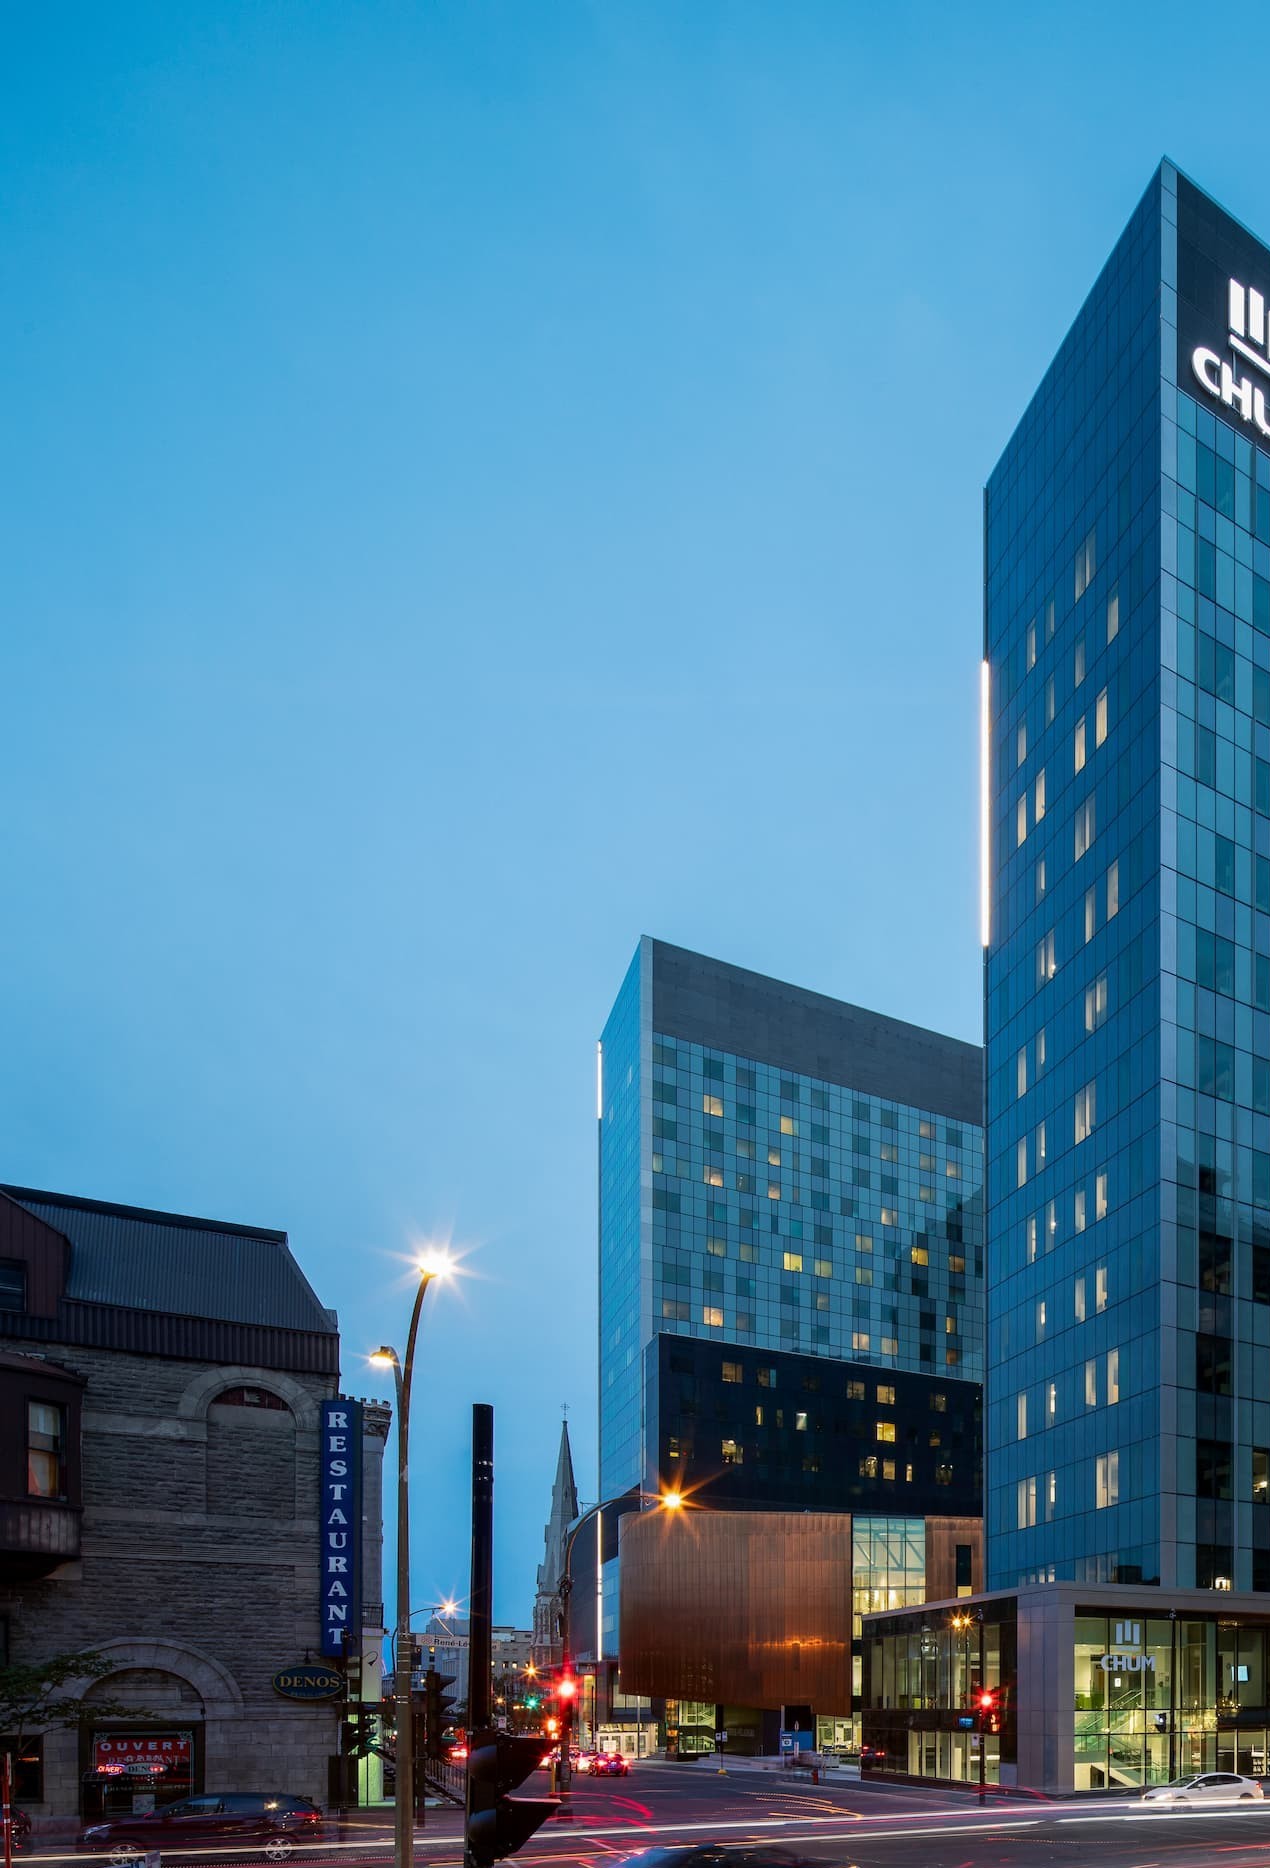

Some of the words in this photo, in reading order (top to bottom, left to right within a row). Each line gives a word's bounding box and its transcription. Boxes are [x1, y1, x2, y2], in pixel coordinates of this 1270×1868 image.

[327, 1411, 349, 1644] RESTAURANT
[1100, 1654, 1156, 1672] CHUM
[279, 1676, 341, 1688] DENOS
[100, 1741, 187, 1751] OUVERT
